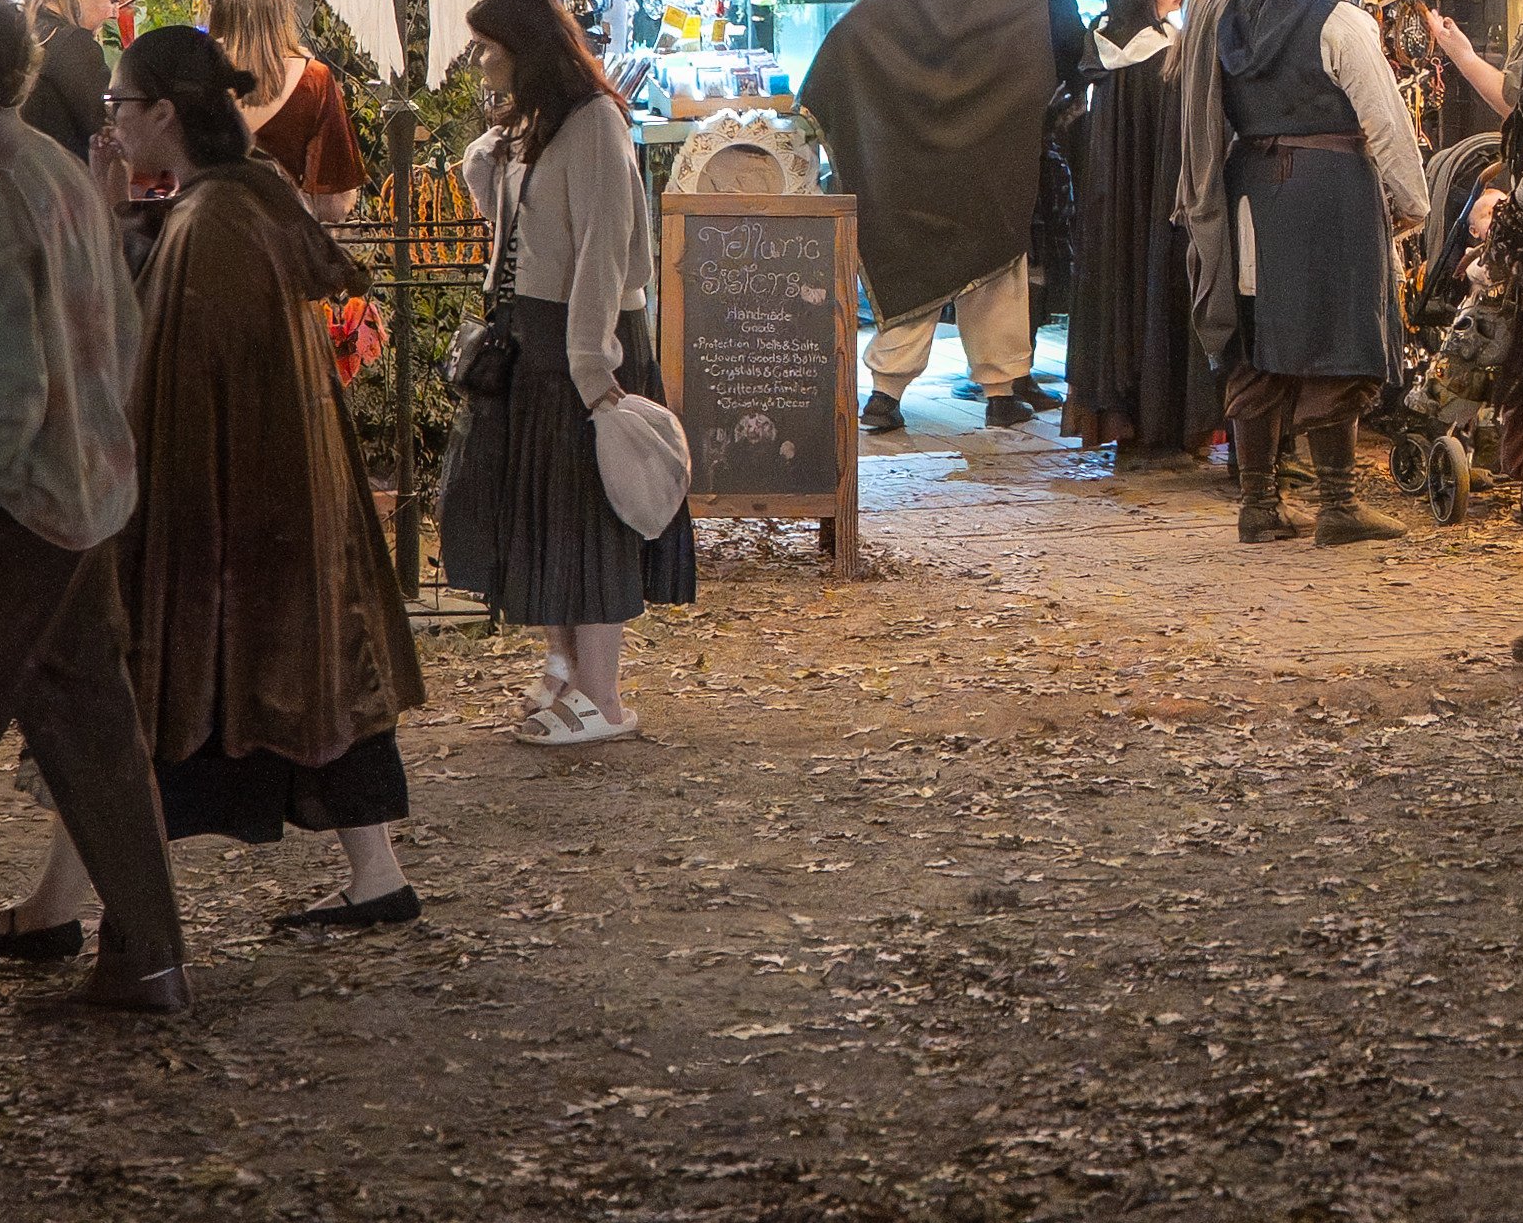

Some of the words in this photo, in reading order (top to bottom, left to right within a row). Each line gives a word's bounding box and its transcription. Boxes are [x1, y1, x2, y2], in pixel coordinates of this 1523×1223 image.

[698, 222, 821, 259] Telluric
[699, 260, 801, 298] Sisters
[727, 305, 793, 322] Handmade
[741, 321, 776, 333] Goods
